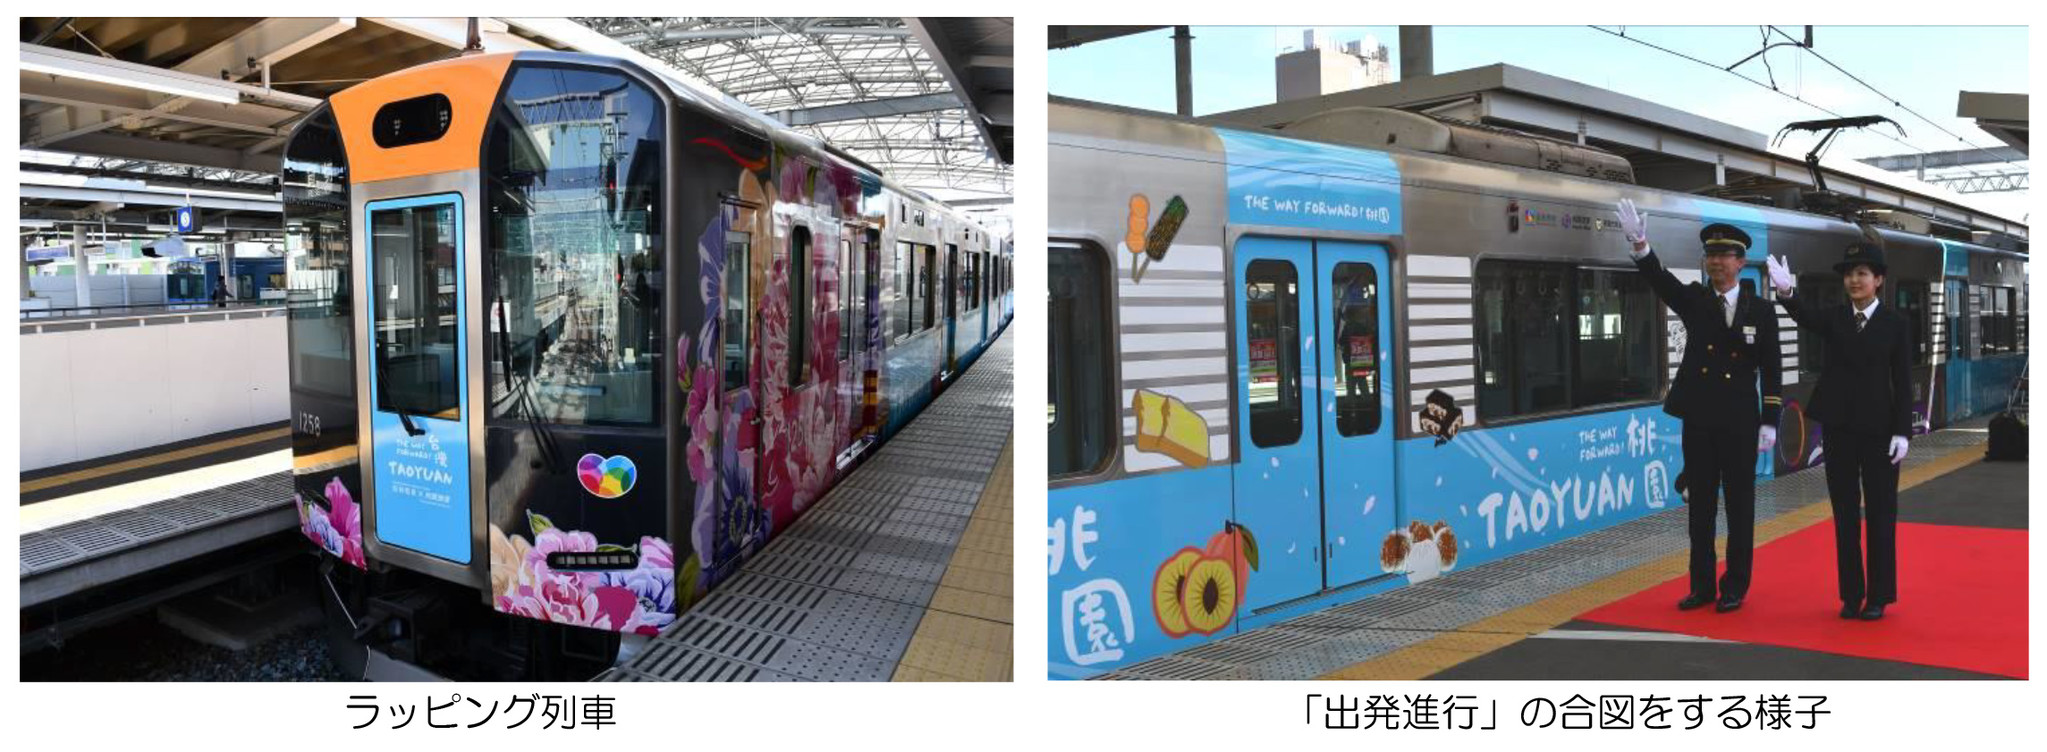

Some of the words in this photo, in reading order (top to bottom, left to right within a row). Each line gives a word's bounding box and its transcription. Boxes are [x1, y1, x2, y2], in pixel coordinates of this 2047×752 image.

[1244, 194, 1270, 211] THE
[1274, 199, 1301, 212] WAY
[1305, 201, 1363, 218] FORWARD!
[299, 409, 321, 438] 1258
[1579, 430, 1596, 445] THE
[1599, 425, 1618, 441] WAY
[1579, 441, 1625, 463] FORWARD!
[388, 460, 453, 487] TAOYUAN
[1477, 470, 1635, 549] TAOYUAN
